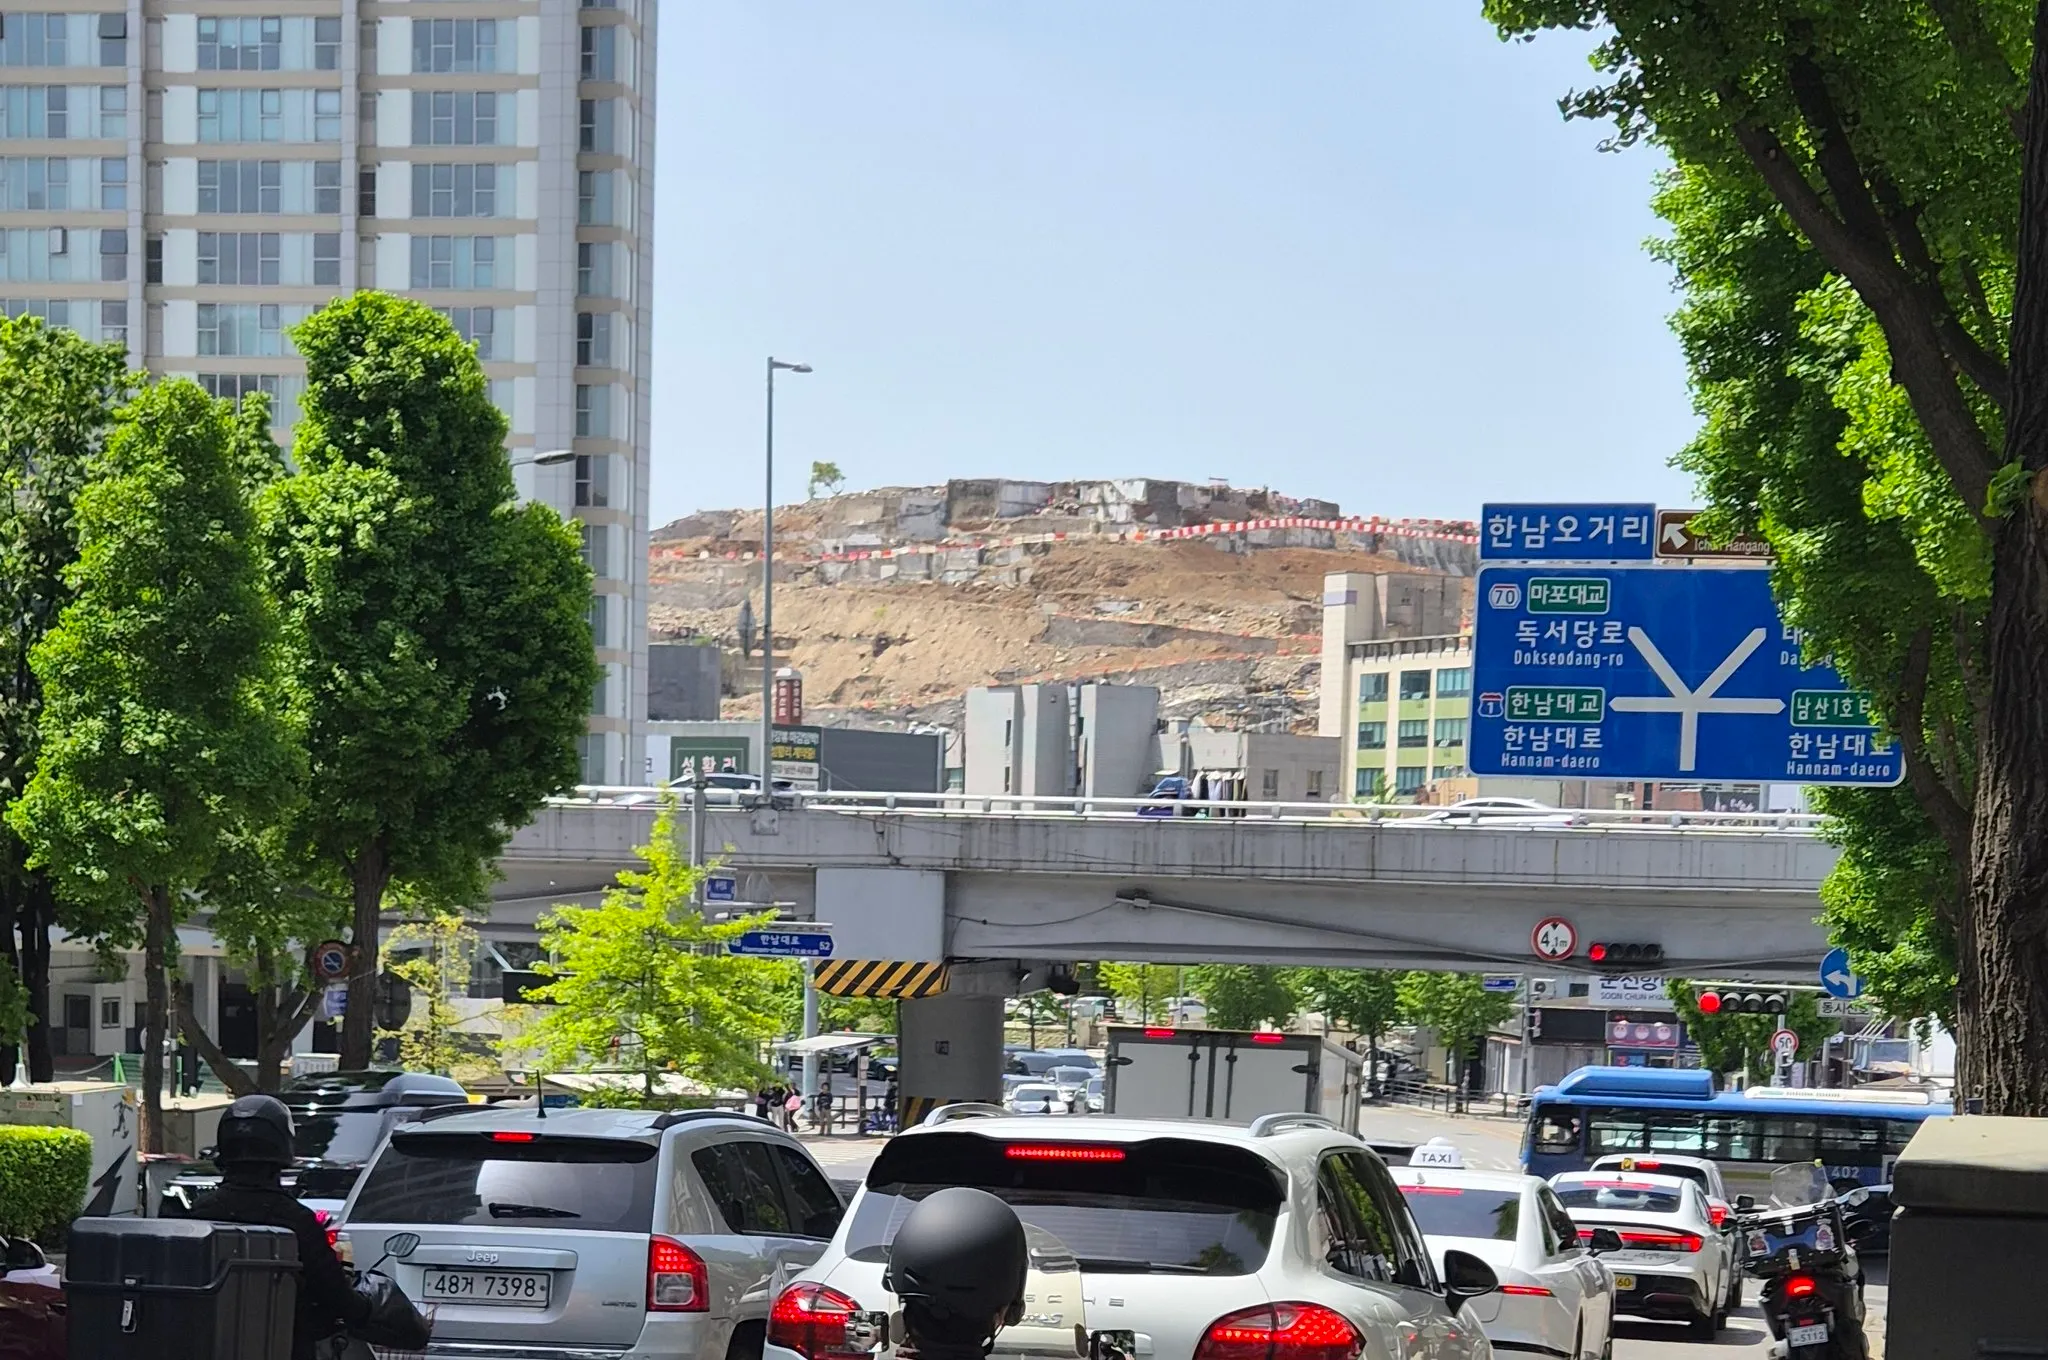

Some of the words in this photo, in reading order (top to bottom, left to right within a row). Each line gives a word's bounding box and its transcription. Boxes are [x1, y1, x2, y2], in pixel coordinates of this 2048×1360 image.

[1488, 514, 1649, 549] 한남오거리
[1495, 590, 1515, 604] 70
[1531, 584, 1606, 605] 마포대교
[1515, 620, 1625, 648] 독서당로
[1513, 650, 1624, 668] Dokseodang-ro
[1486, 702, 1494, 714] 1
[1511, 692, 1599, 716] 한남대교
[1503, 725, 1603, 751] 한남대로
[1501, 753, 1600, 768] Hannam-daero
[1787, 761, 1890, 776] Hannam-daero
[760, 935, 801, 945] 한남대로
[819, 941, 830, 950] 52
[1421, 1152, 1452, 1163] TAXI
[1831, 1166, 1860, 1179] 402
[467, 1250, 499, 1264] Jeep
[434, 1275, 473, 1295] 48거
[484, 1276, 536, 1297] 7398
